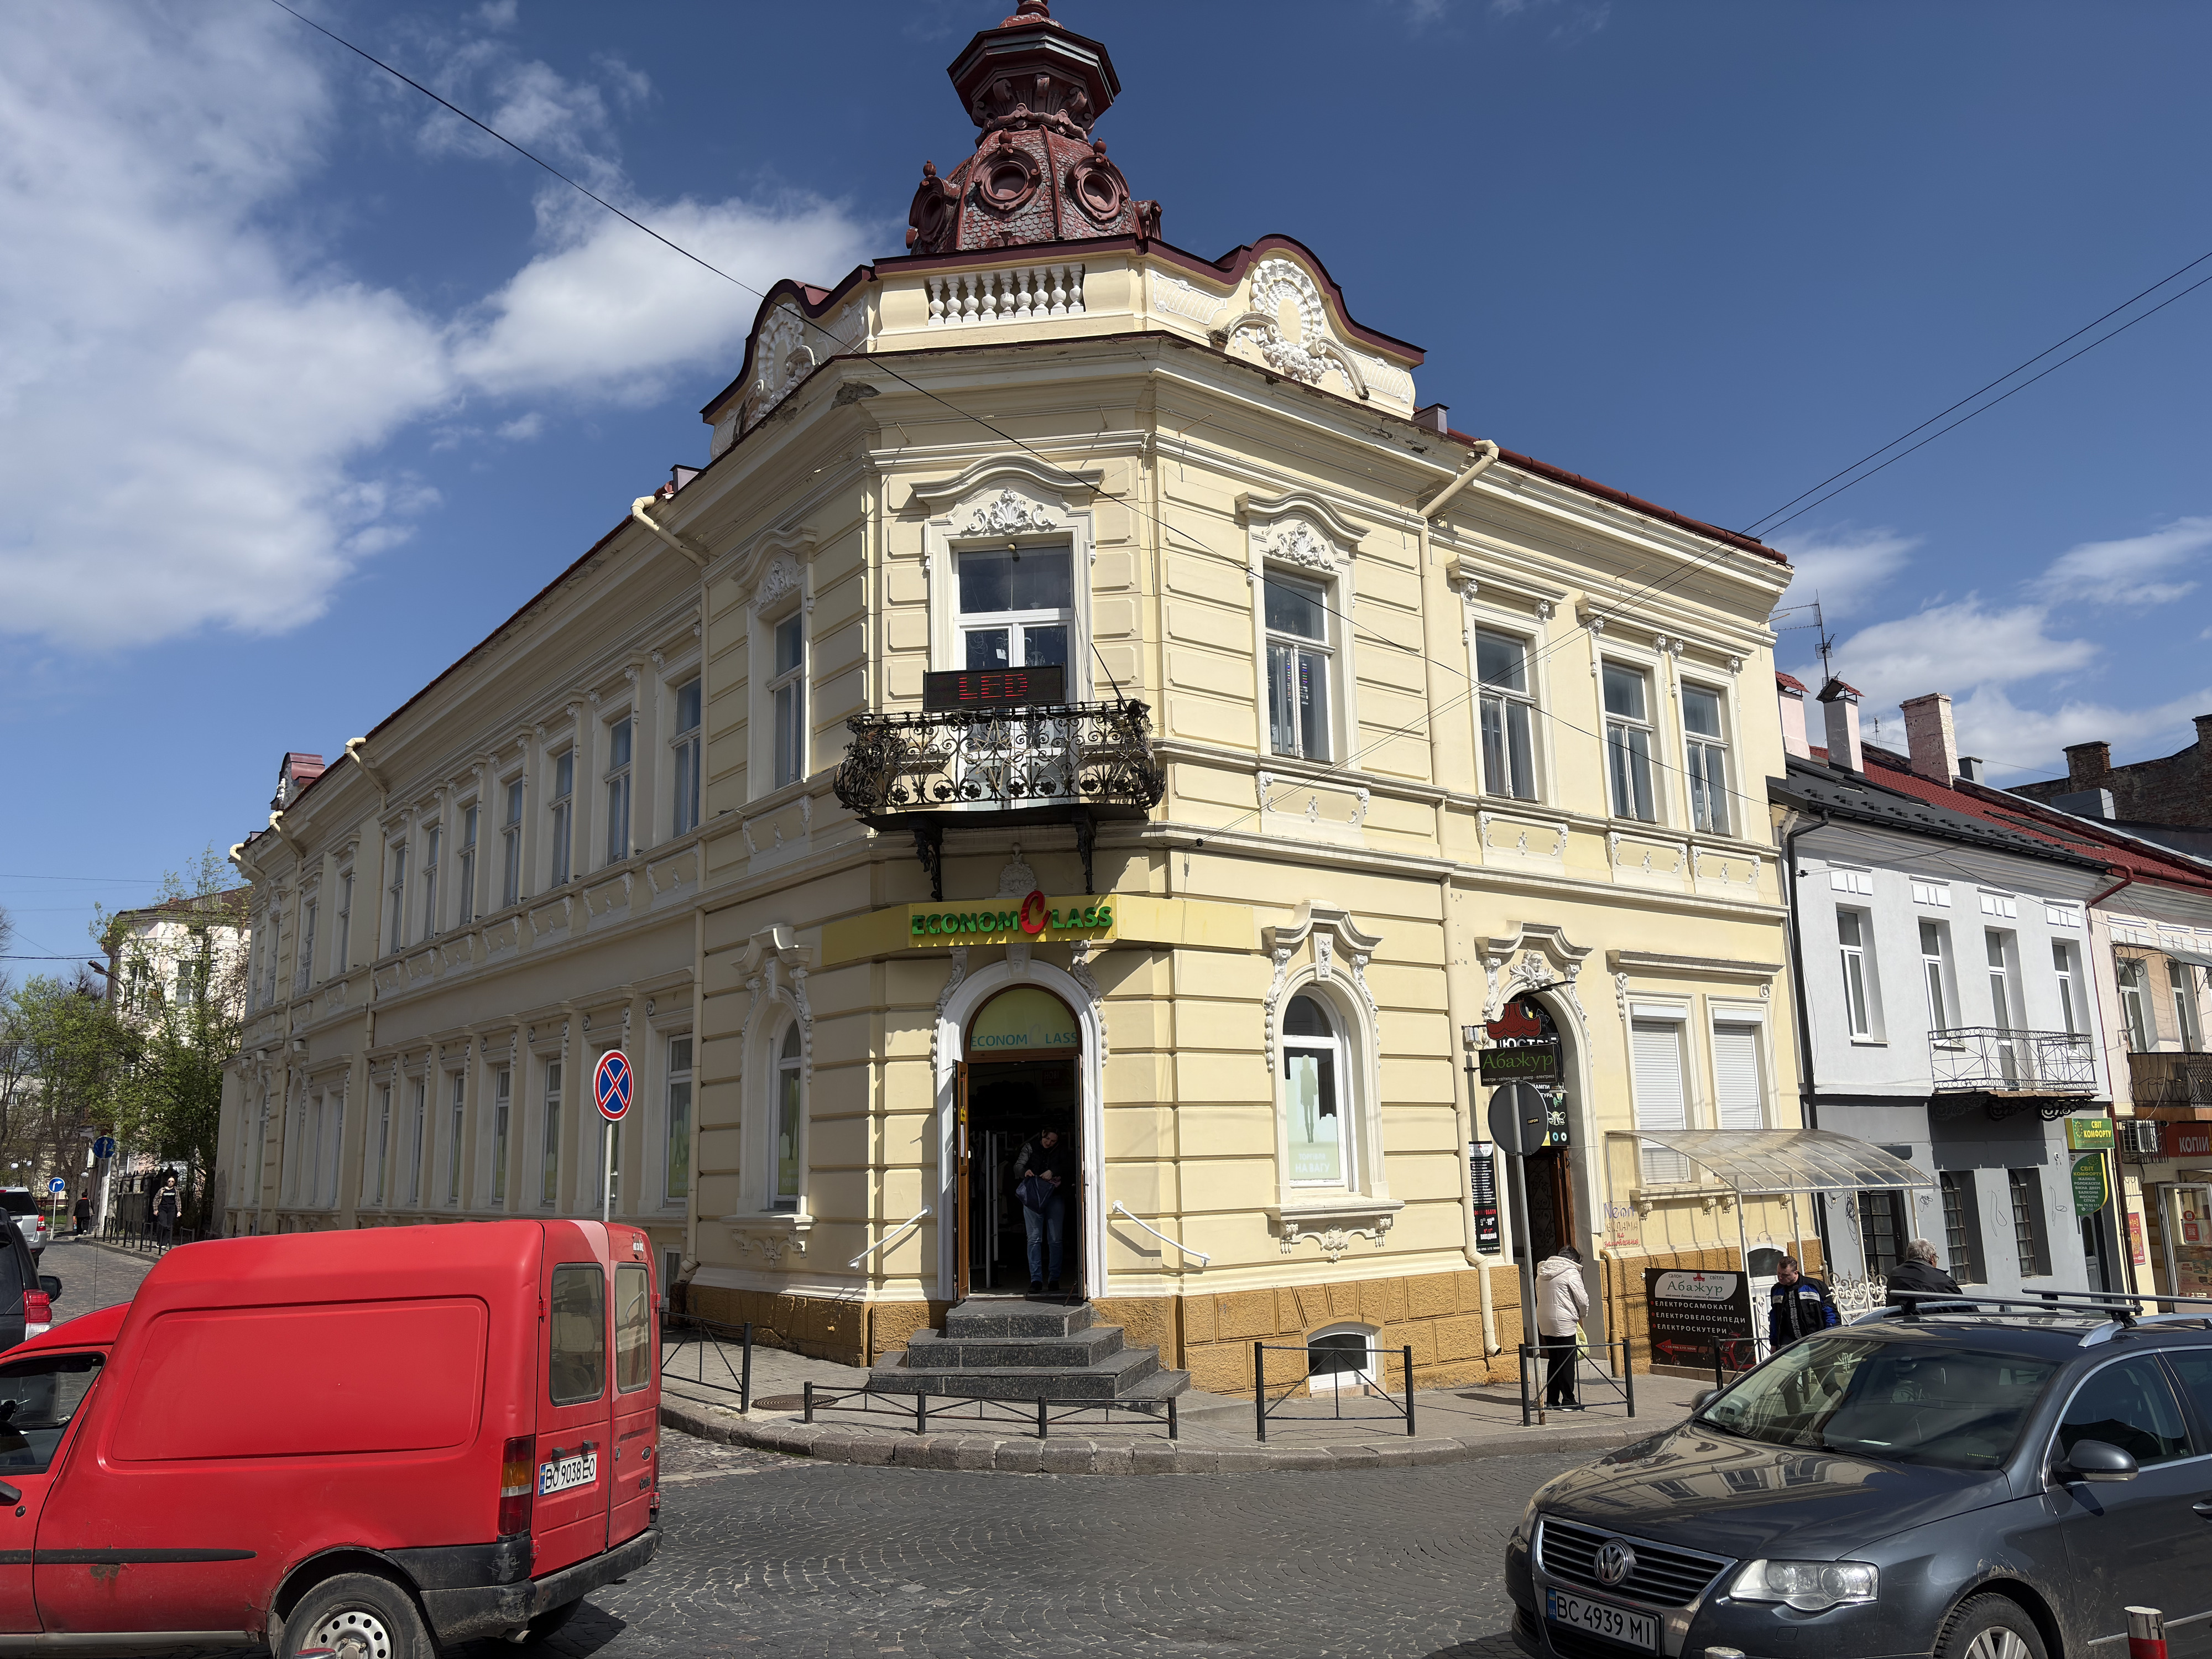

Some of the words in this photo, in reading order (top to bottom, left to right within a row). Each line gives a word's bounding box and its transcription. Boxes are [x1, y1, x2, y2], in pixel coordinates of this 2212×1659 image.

[959, 674, 1028, 700] LED
[1482, 1051, 1553, 1072] Абажур
[2091, 1120, 2102, 1129] СВІТ
[2083, 1130, 2111, 1138] КОМФОРТУ
[1295, 1163, 1308, 1173] НА
[1309, 1163, 1330, 1173] ВАГУ
[1667, 1280, 1723, 1296] Абажур
[1655, 1301, 1734, 1311] ЕЛЕКТРОСАМОКАТИ
[1656, 1312, 1746, 1324] ЕЛЕКТРОВЕЛОСИПЕДИ
[1657, 1324, 1727, 1334] ЕЛЕКТРОСКУТЕРИ
[545, 1467, 559, 1490] BO
[561, 1463, 581, 1485] 9038
[582, 1457, 595, 1479] EO
[1549, 1608, 1556, 1616] UA
[1557, 1595, 1579, 1623] BC
[1583, 1605, 1624, 1636] 4939
[1630, 1616, 1650, 1645] MI
